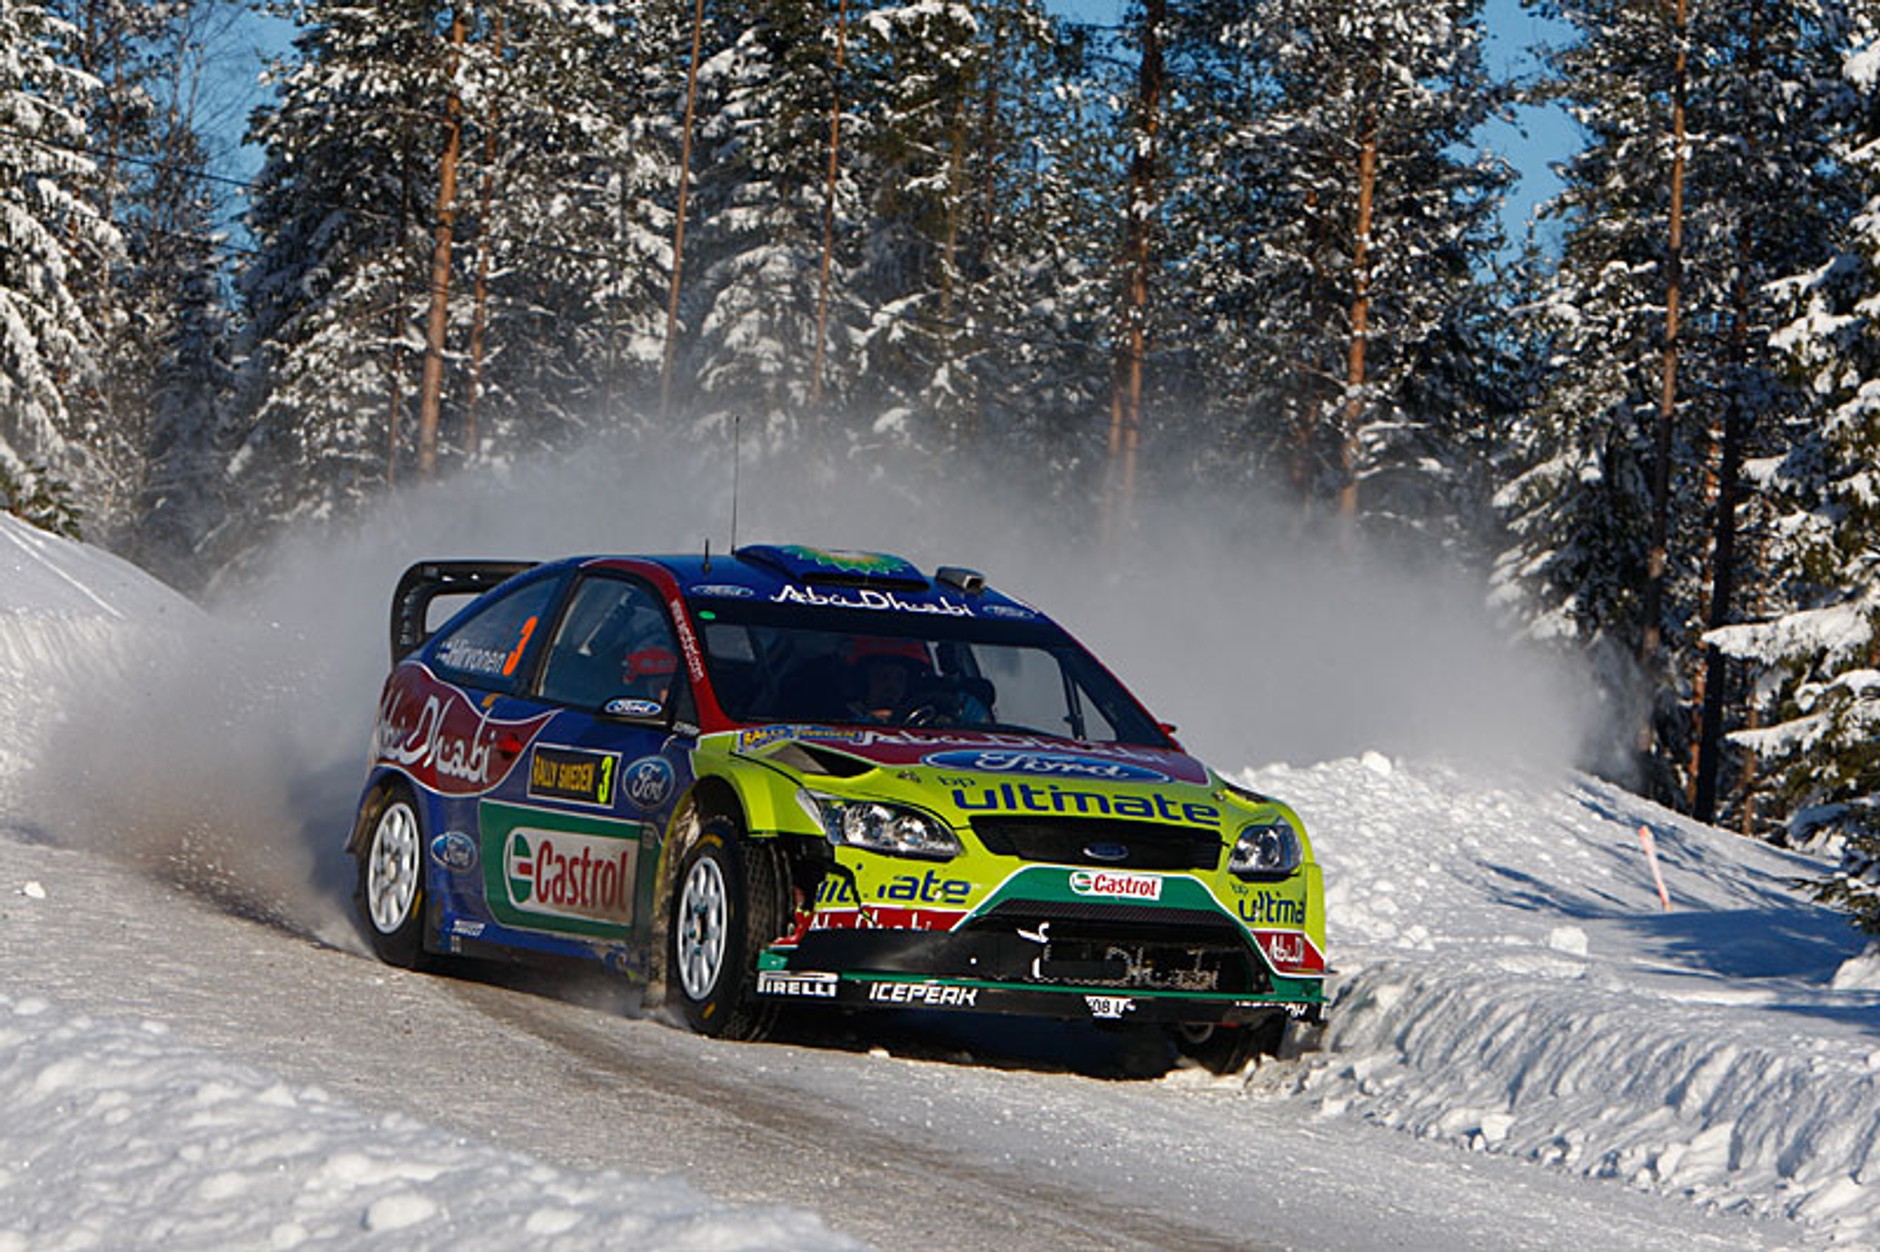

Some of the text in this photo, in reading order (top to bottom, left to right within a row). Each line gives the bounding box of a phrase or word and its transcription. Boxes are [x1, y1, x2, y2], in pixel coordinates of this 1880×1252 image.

[502, 615, 538, 677] 3
[534, 755, 596, 793] RALLY SWEDEN
[597, 755, 614, 804] 3
[631, 762, 667, 802] Ford
[974, 751, 1129, 779] Ford
[951, 783, 1222, 827] ultimate
[535, 839, 629, 913] Castrol
[1093, 872, 1157, 897] Castrol
[756, 970, 839, 998] PIRELLI
[868, 981, 979, 1007] ICEPEAK
